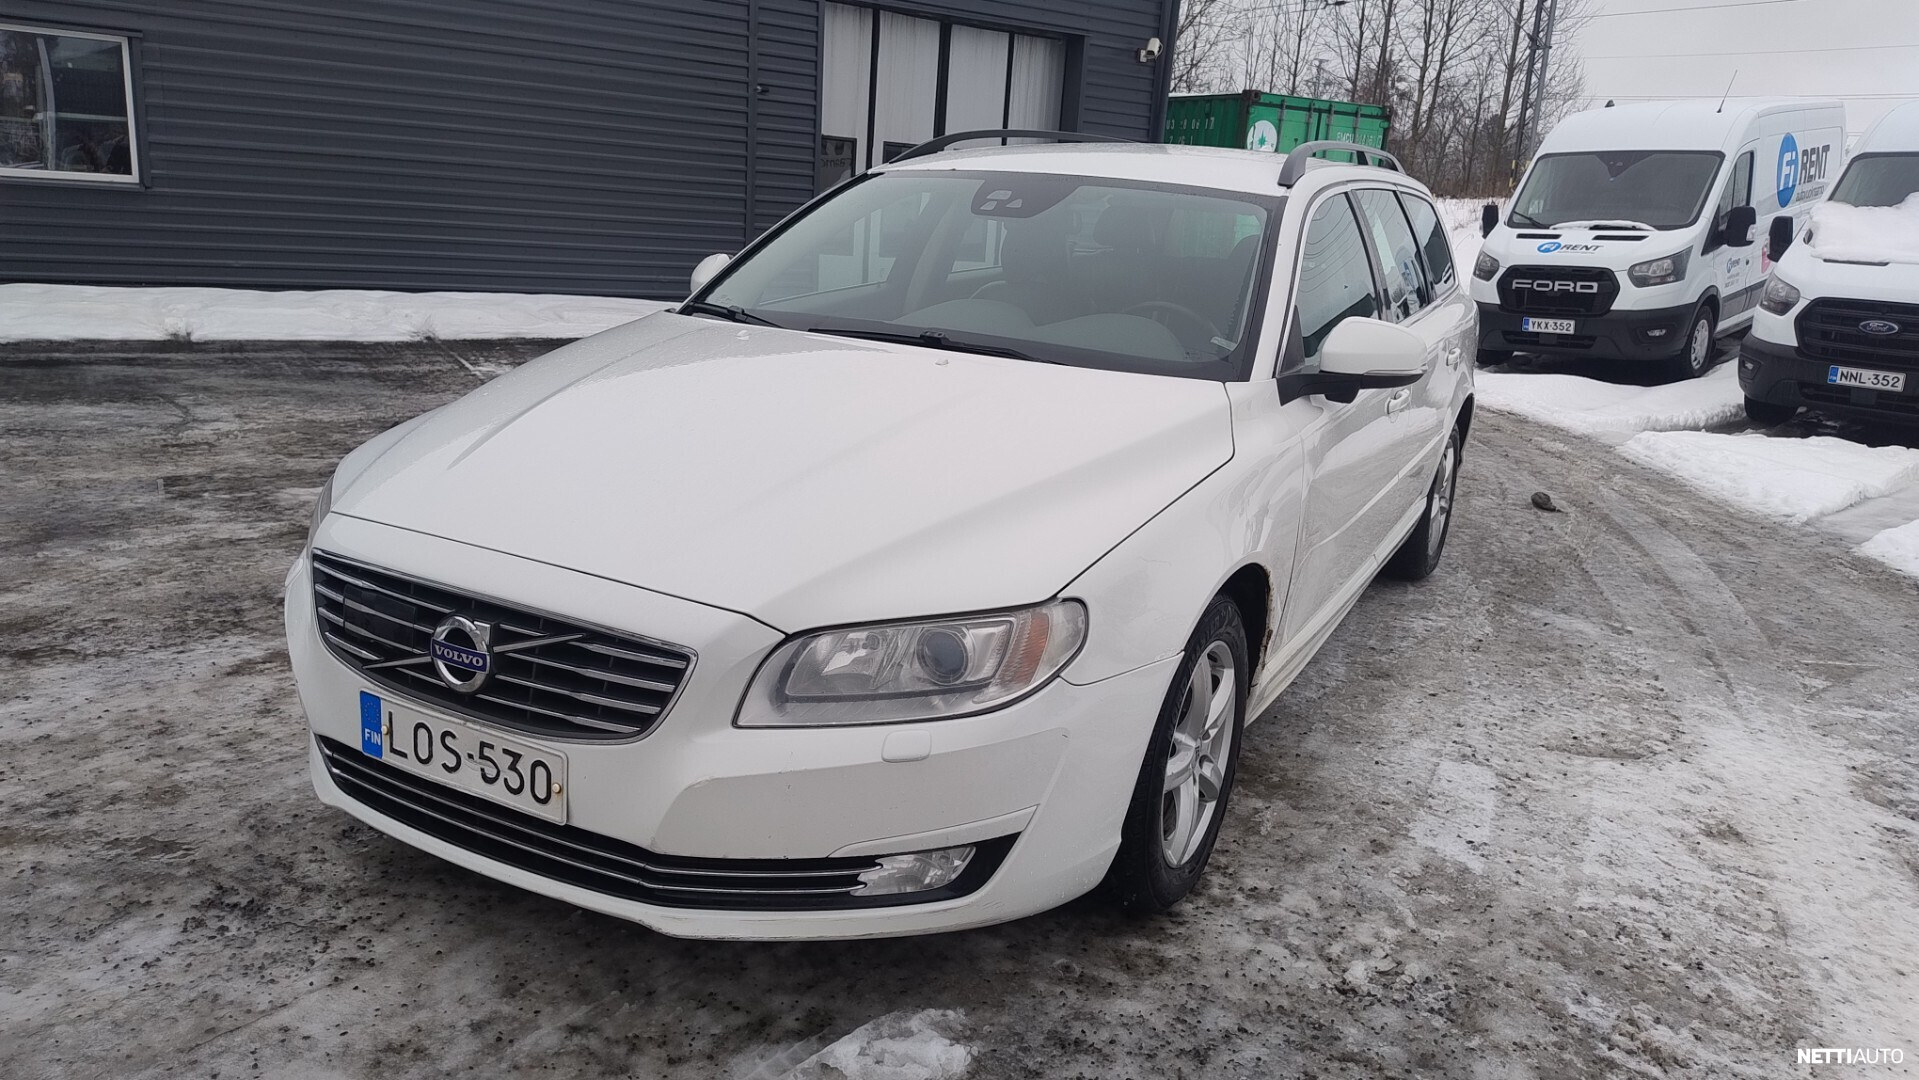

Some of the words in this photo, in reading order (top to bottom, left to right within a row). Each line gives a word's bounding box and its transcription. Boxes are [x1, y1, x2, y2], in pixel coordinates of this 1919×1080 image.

[1799, 144, 1830, 185] RENT
[1512, 279, 1598, 293] FORD
[1531, 320, 1572, 332] YKX-352
[1866, 322, 1889, 332] Ford
[1839, 370, 1901, 388] NNL-352
[434, 644, 484, 667] VOLVO
[364, 728, 382, 746] FIN
[388, 710, 552, 805] LOS-530
